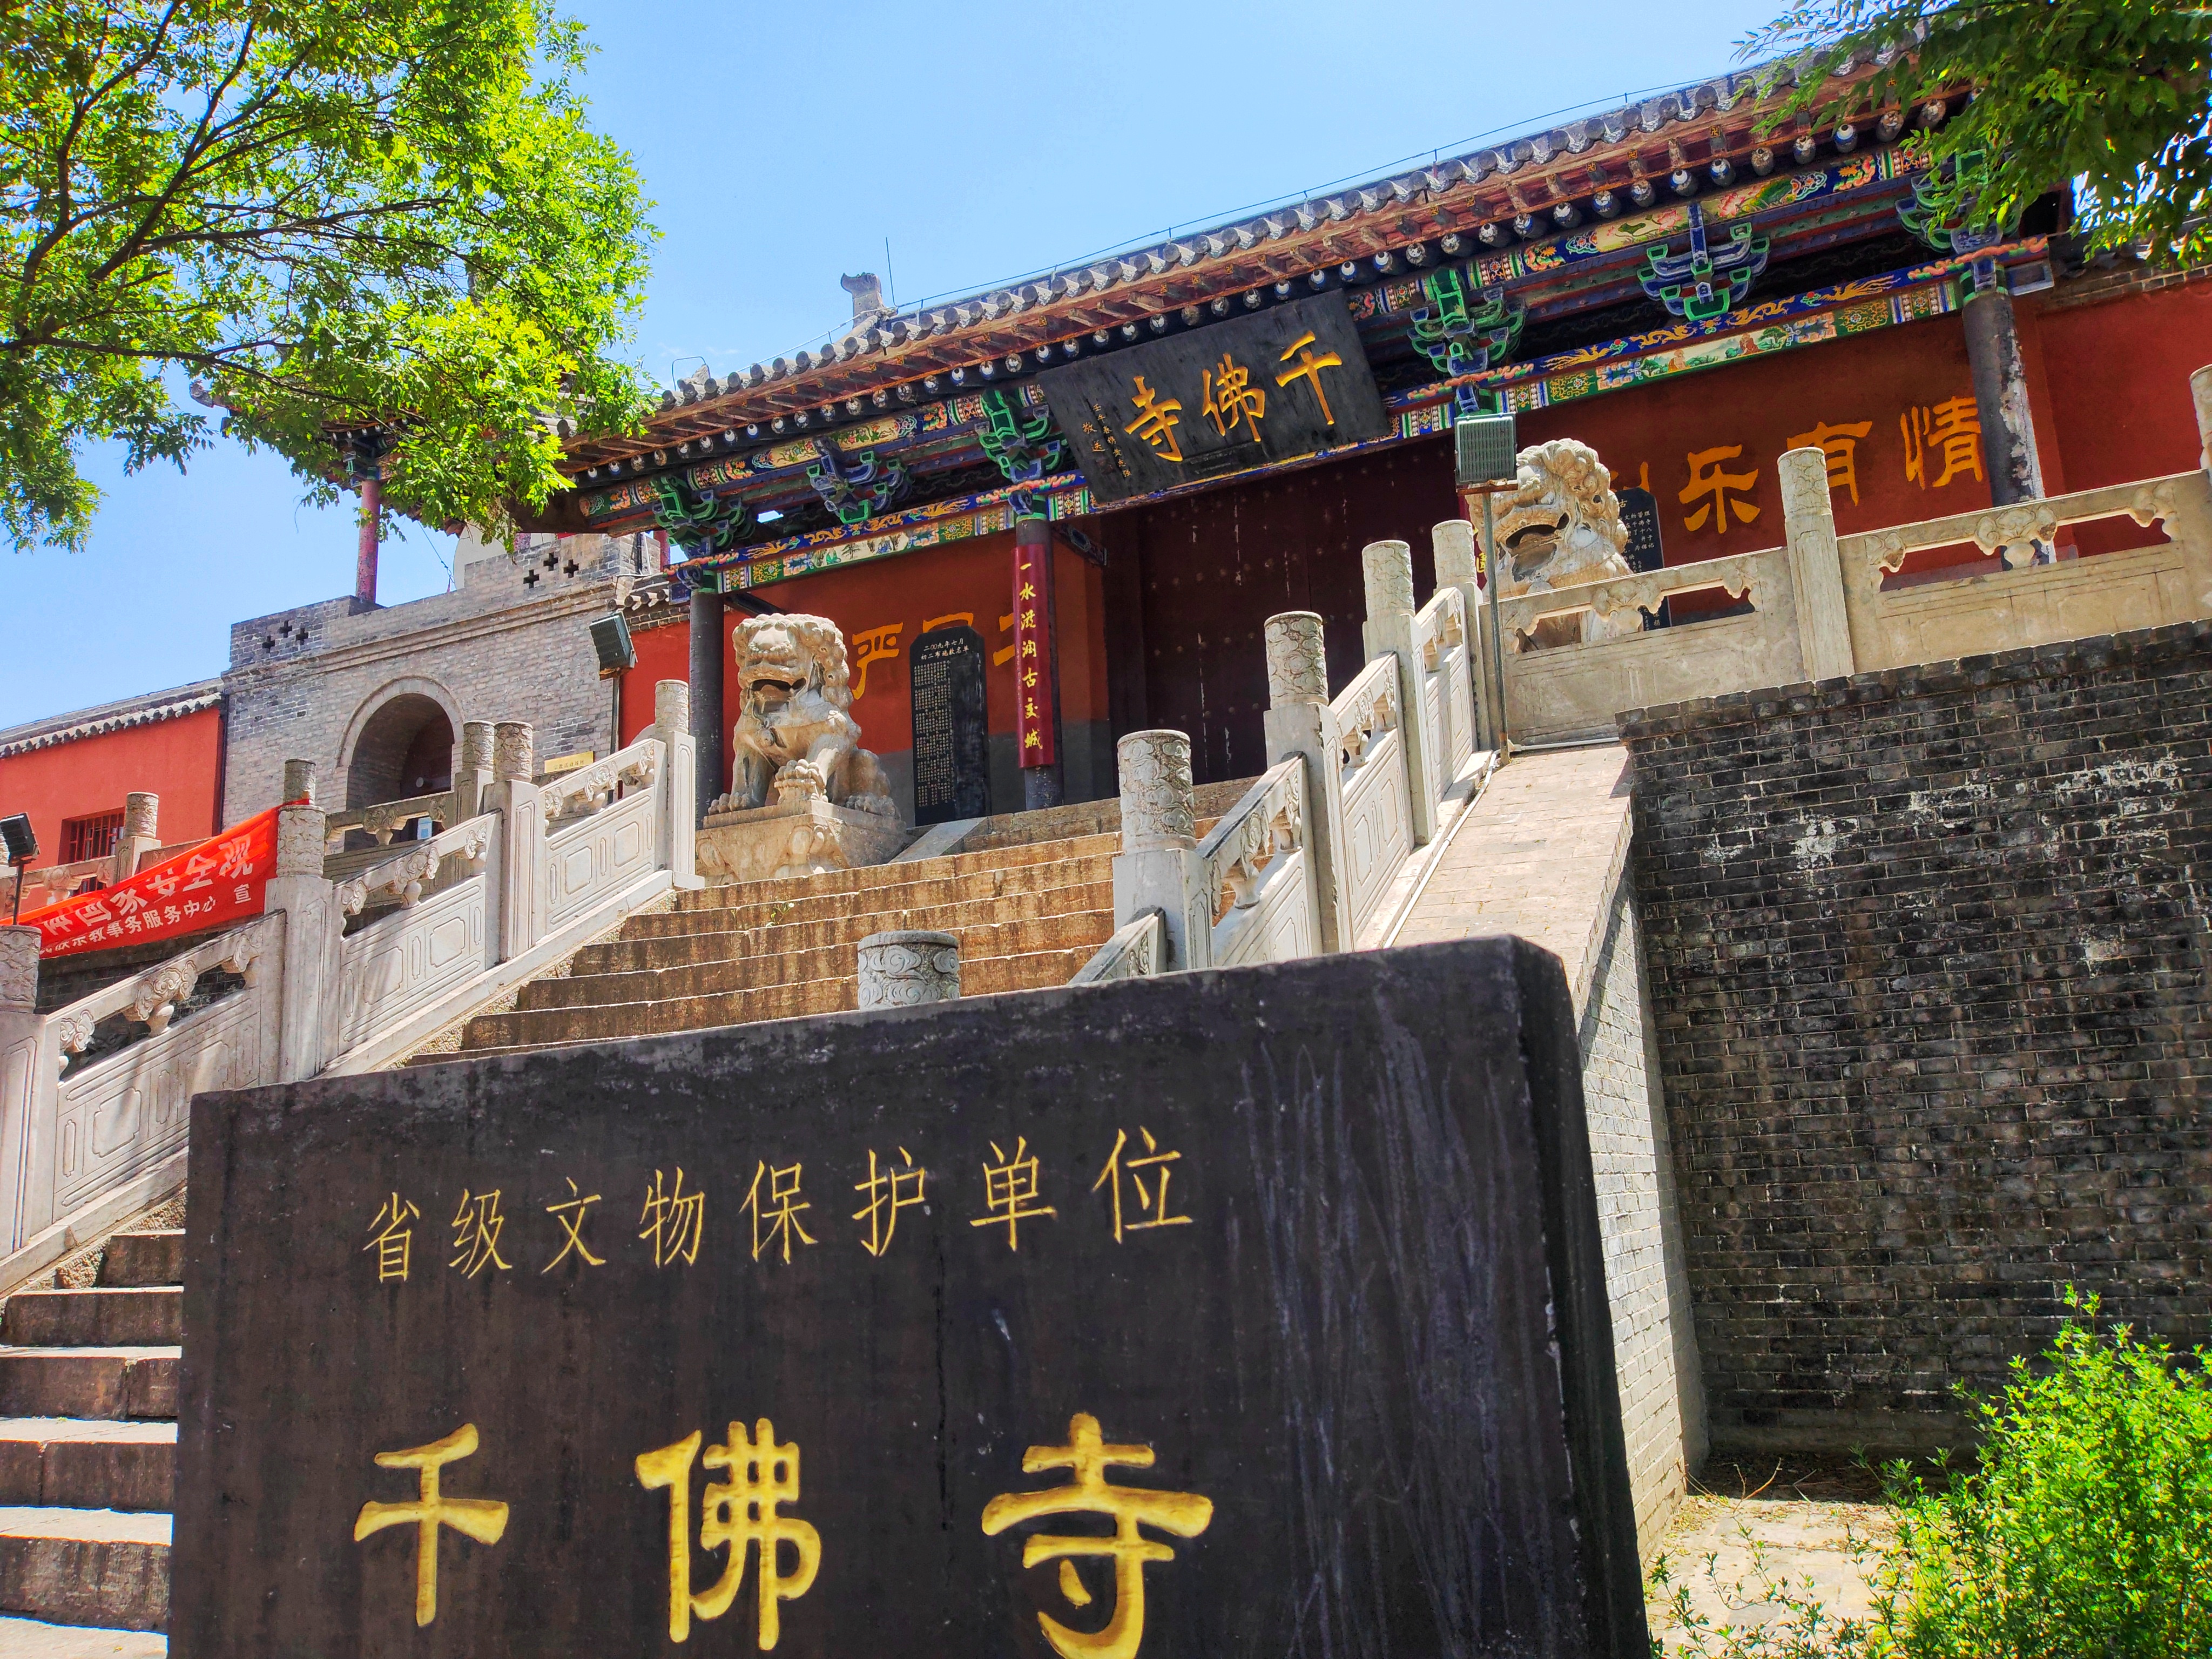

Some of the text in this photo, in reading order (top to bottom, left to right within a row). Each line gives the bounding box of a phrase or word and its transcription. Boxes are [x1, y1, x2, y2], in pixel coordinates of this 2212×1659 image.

[1124, 331, 1343, 462] 千佛寺
[1020, 563, 1043, 750] 一水滋润古交城
[234, 884, 252, 904] 宣
[363, 1127, 1192, 1282] 省级文物保护单位
[354, 1412, 1213, 1659] 千佛寺
